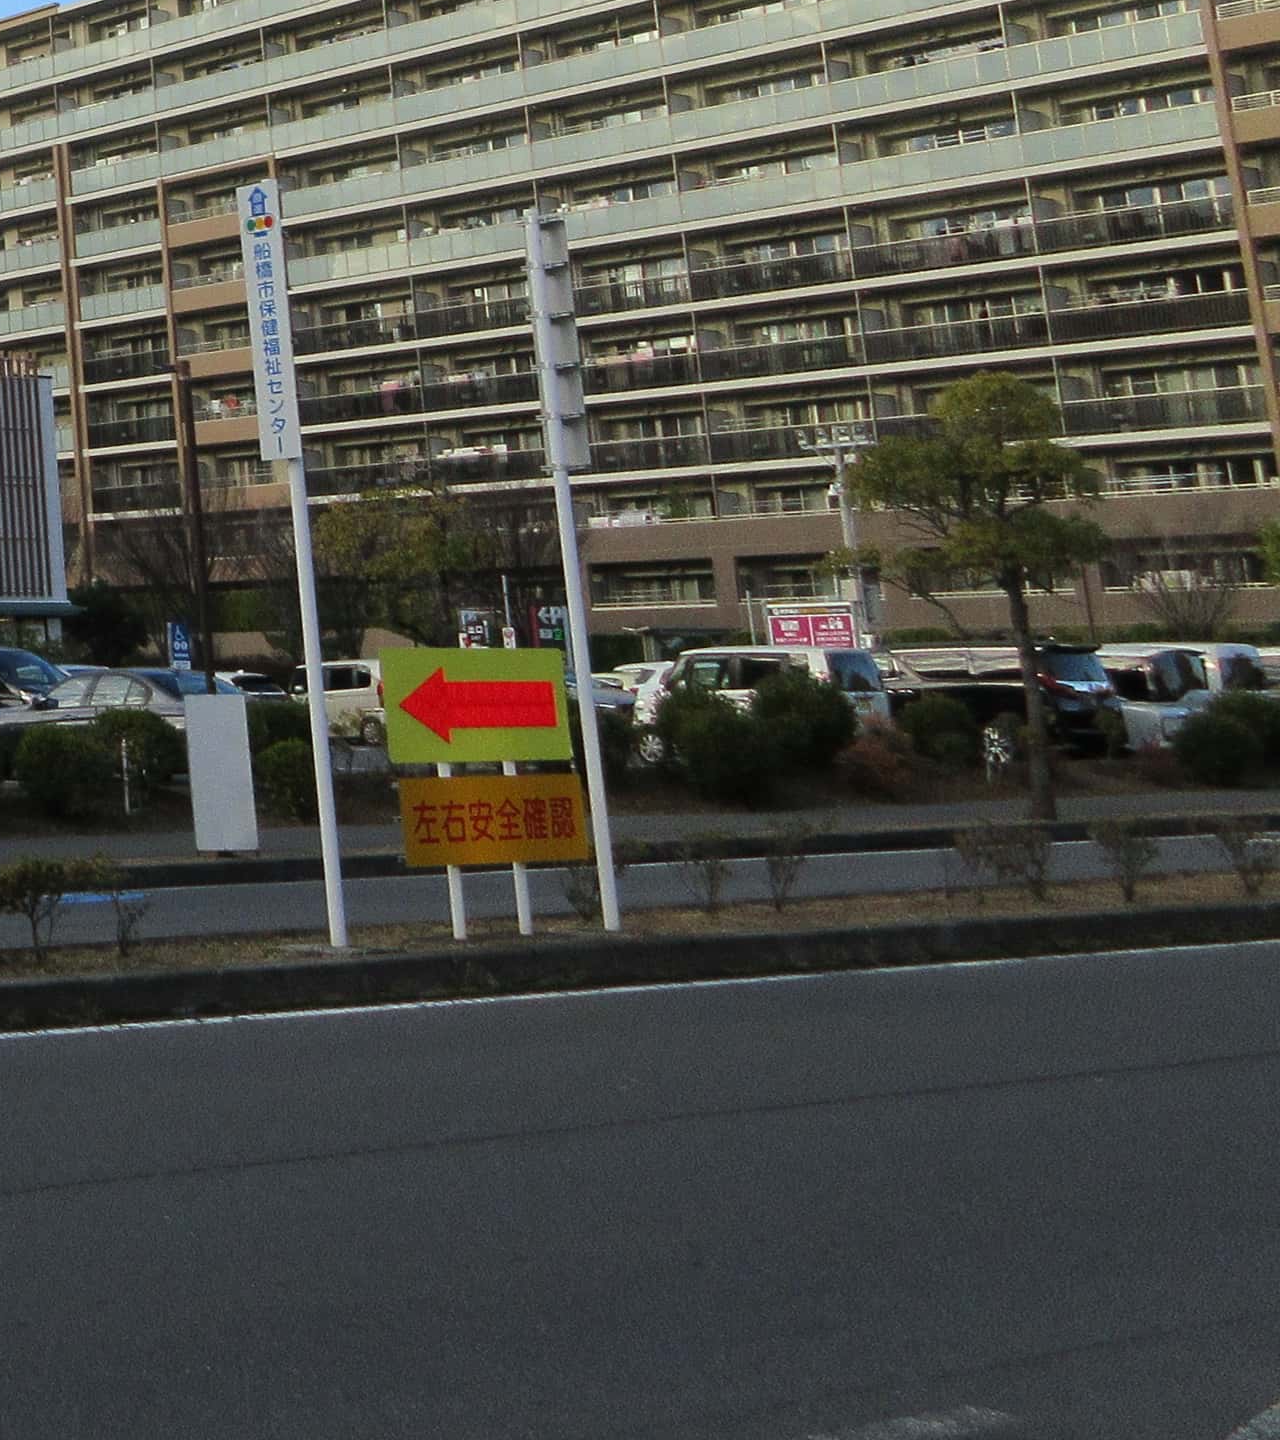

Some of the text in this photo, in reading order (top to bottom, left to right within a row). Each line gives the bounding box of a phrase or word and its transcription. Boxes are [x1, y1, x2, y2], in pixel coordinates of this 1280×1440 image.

[254, 243, 286, 453] 船橋市保健福祉センター
[412, 797, 577, 845] 左右安全確認
